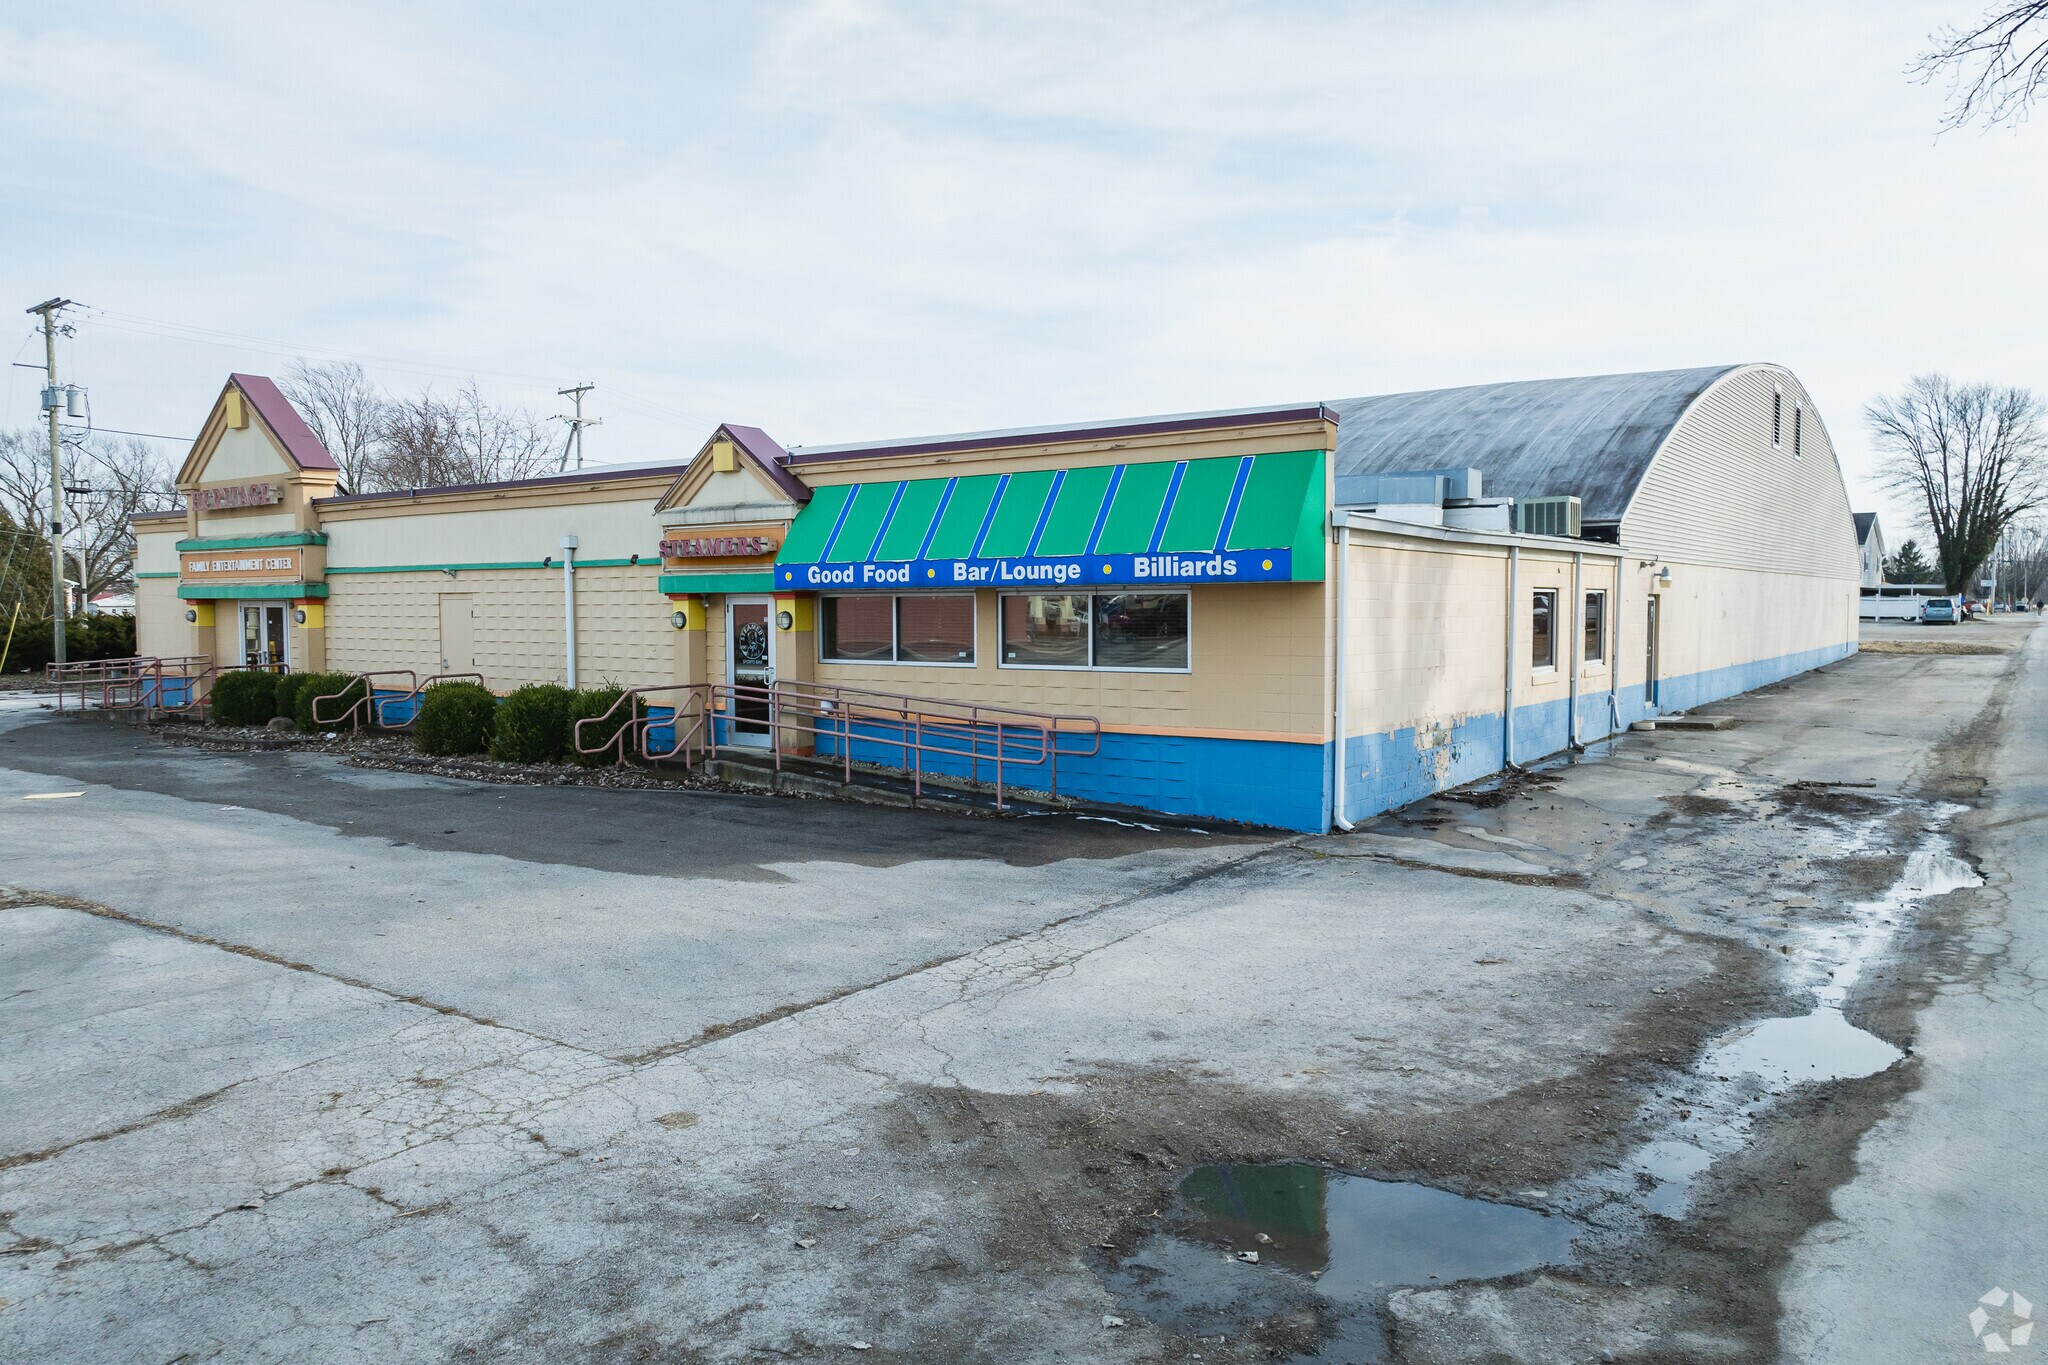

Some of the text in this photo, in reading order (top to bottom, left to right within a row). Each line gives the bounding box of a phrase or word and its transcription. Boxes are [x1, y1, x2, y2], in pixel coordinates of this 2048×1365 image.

[191, 484, 271, 512] HERITAGE
[659, 537, 761, 557] STEAMERS
[188, 558, 292, 572] FAMILY ENTERTAINMENT CENTER
[807, 565, 854, 584] Good
[863, 564, 910, 583] Food
[1134, 555, 1237, 577] Billiards
